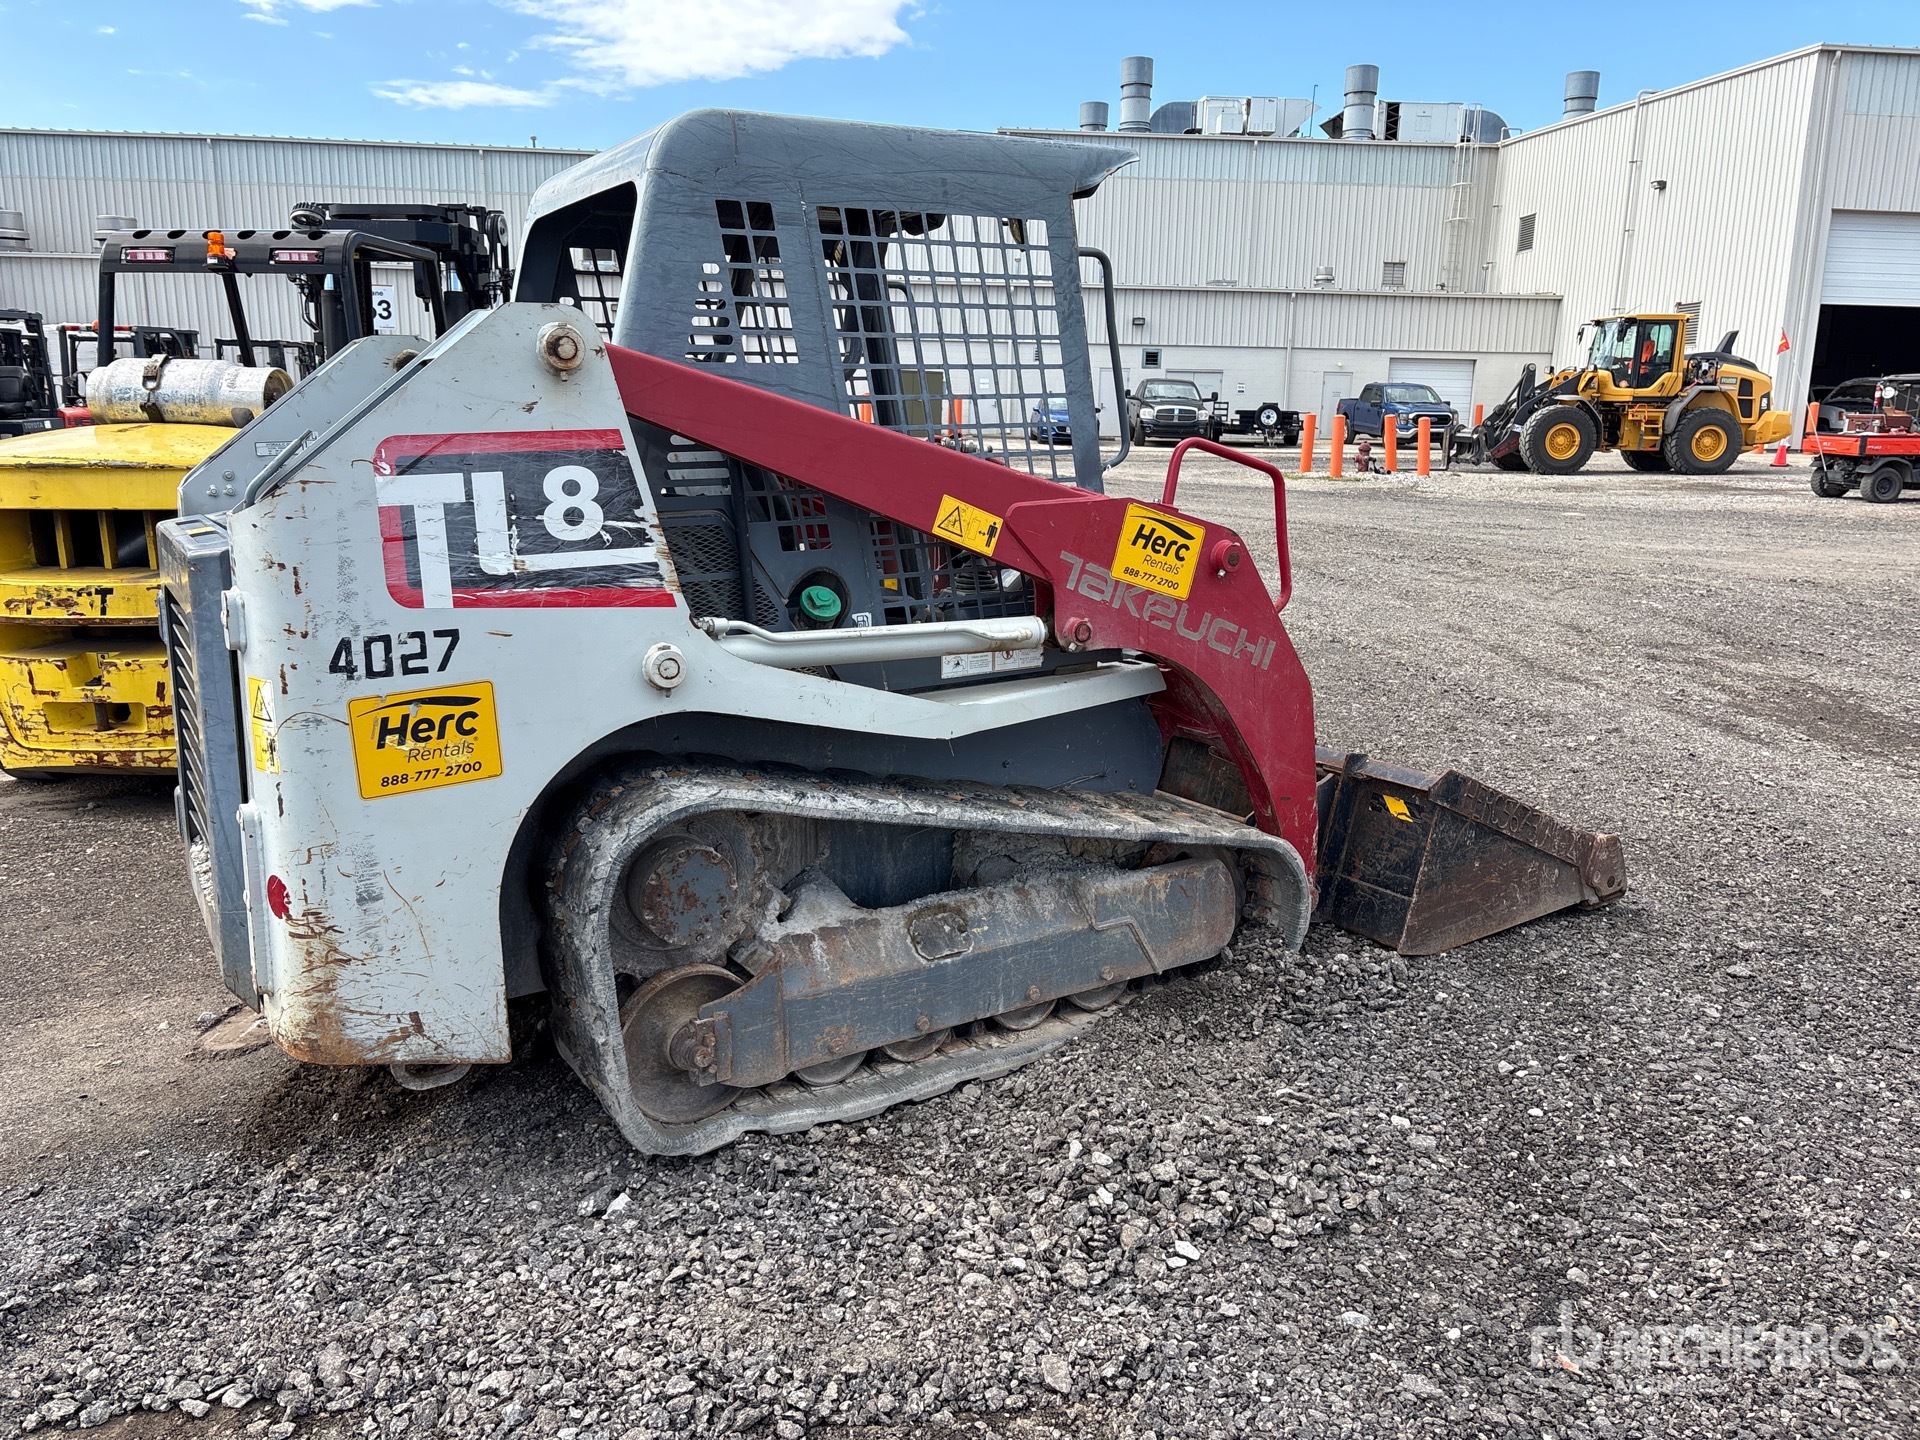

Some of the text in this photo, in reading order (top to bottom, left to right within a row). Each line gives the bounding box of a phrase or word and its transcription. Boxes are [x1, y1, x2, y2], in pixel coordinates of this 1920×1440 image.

[24, 421, 44, 429] TOYOTA
[1131, 523, 1190, 562] Herc
[1123, 566, 1179, 591] 888-777-2700
[329, 628, 460, 681] 4027
[376, 710, 480, 750] Herc
[380, 761, 483, 788] 888-777-2700
